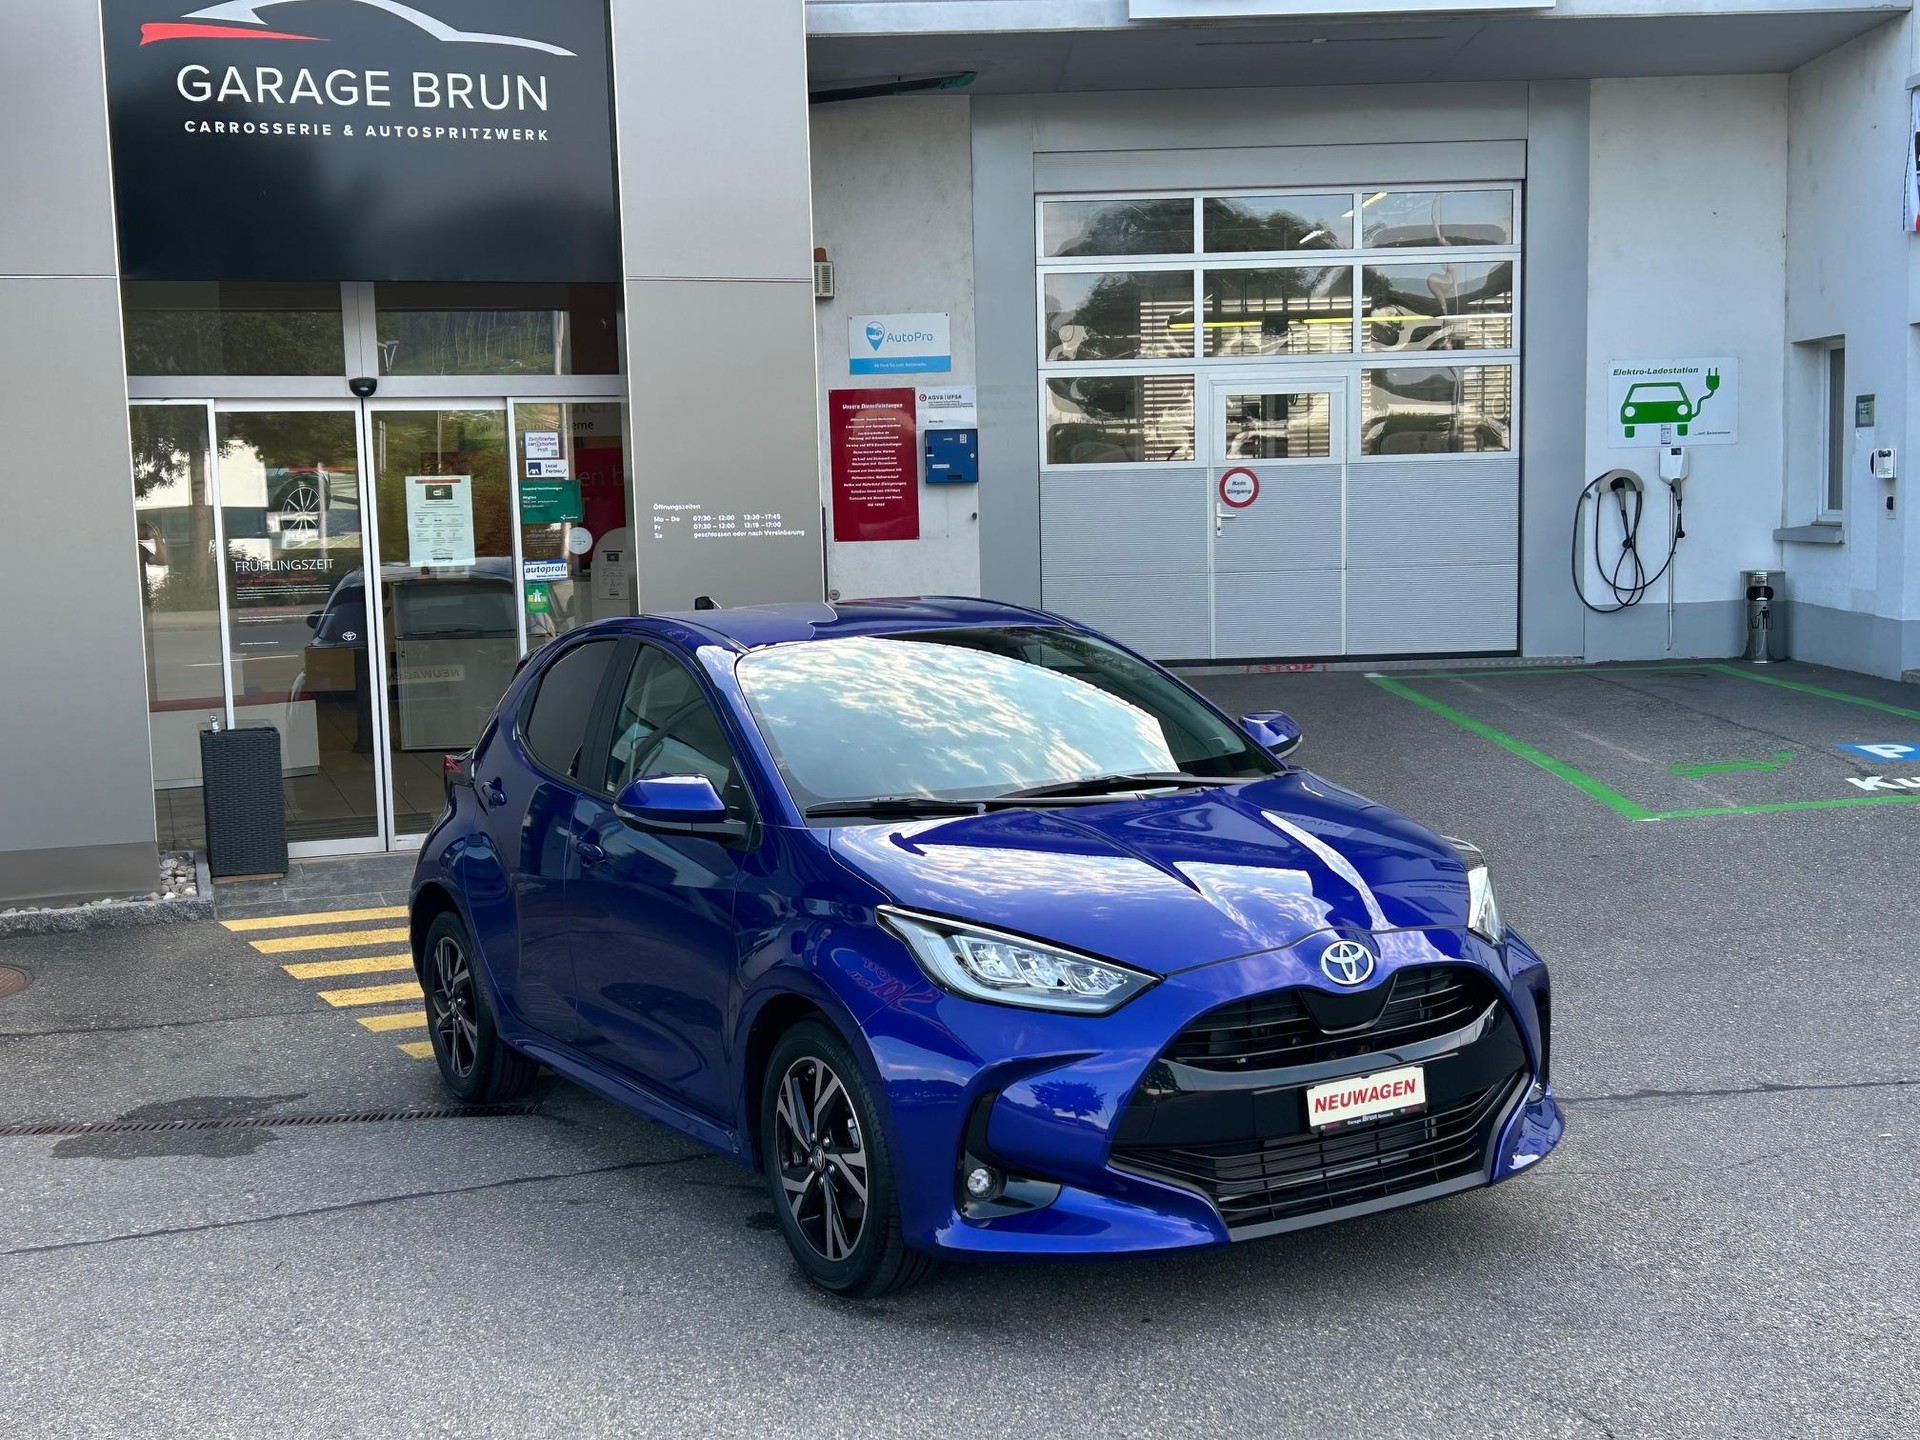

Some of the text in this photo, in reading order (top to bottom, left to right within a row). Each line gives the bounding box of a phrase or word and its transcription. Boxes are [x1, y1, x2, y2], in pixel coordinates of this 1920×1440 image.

[176, 64, 549, 112] GARAGE BRUN
[184, 120, 549, 142] CARROSSERIE & AUTOSPRITZWERK
[886, 331, 934, 343] AutoPro
[1612, 367, 1699, 376] Elektro-Ladestation
[653, 503, 701, 511] Öffnungszeiten
[694, 531, 732, 539] geschlossen
[764, 529, 805, 537] Vereinbarung
[525, 564, 567, 574] autoprofi
[1259, 663, 1315, 673] STOP
[1855, 744, 1916, 758] P
[1314, 1078, 1416, 1113] NEUWAGEN
